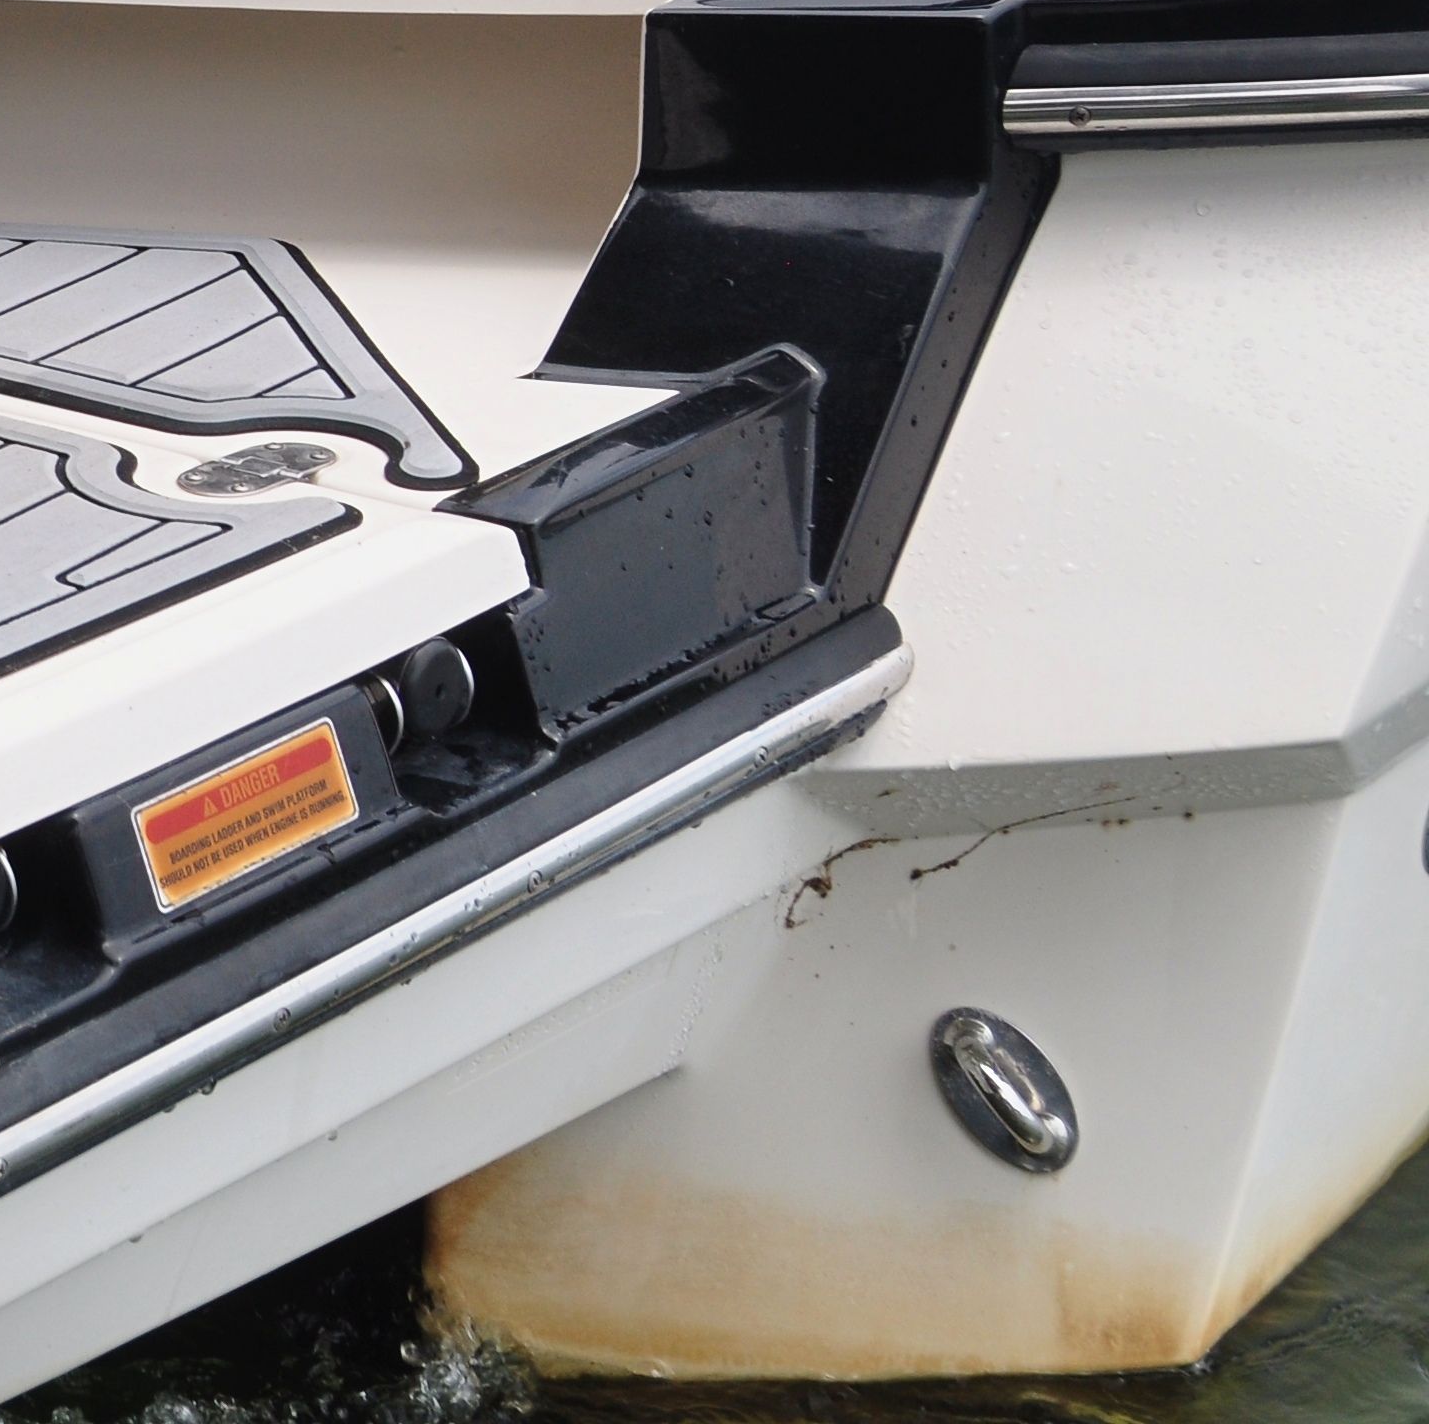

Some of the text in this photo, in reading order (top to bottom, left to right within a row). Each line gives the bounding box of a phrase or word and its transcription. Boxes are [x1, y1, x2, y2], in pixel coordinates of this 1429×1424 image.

[169, 780, 328, 863] BOARDING LADDER AND SWIM PLATFORM
[220, 764, 279, 807] DANGER
[160, 865, 192, 888] SHOULD
[192, 855, 211, 873] NOT
[212, 852, 222, 864] BE
[222, 840, 245, 859] USED
[245, 829, 269, 848] WHEN
[269, 812, 299, 834] ENGINE
[300, 809, 309, 822] IS
